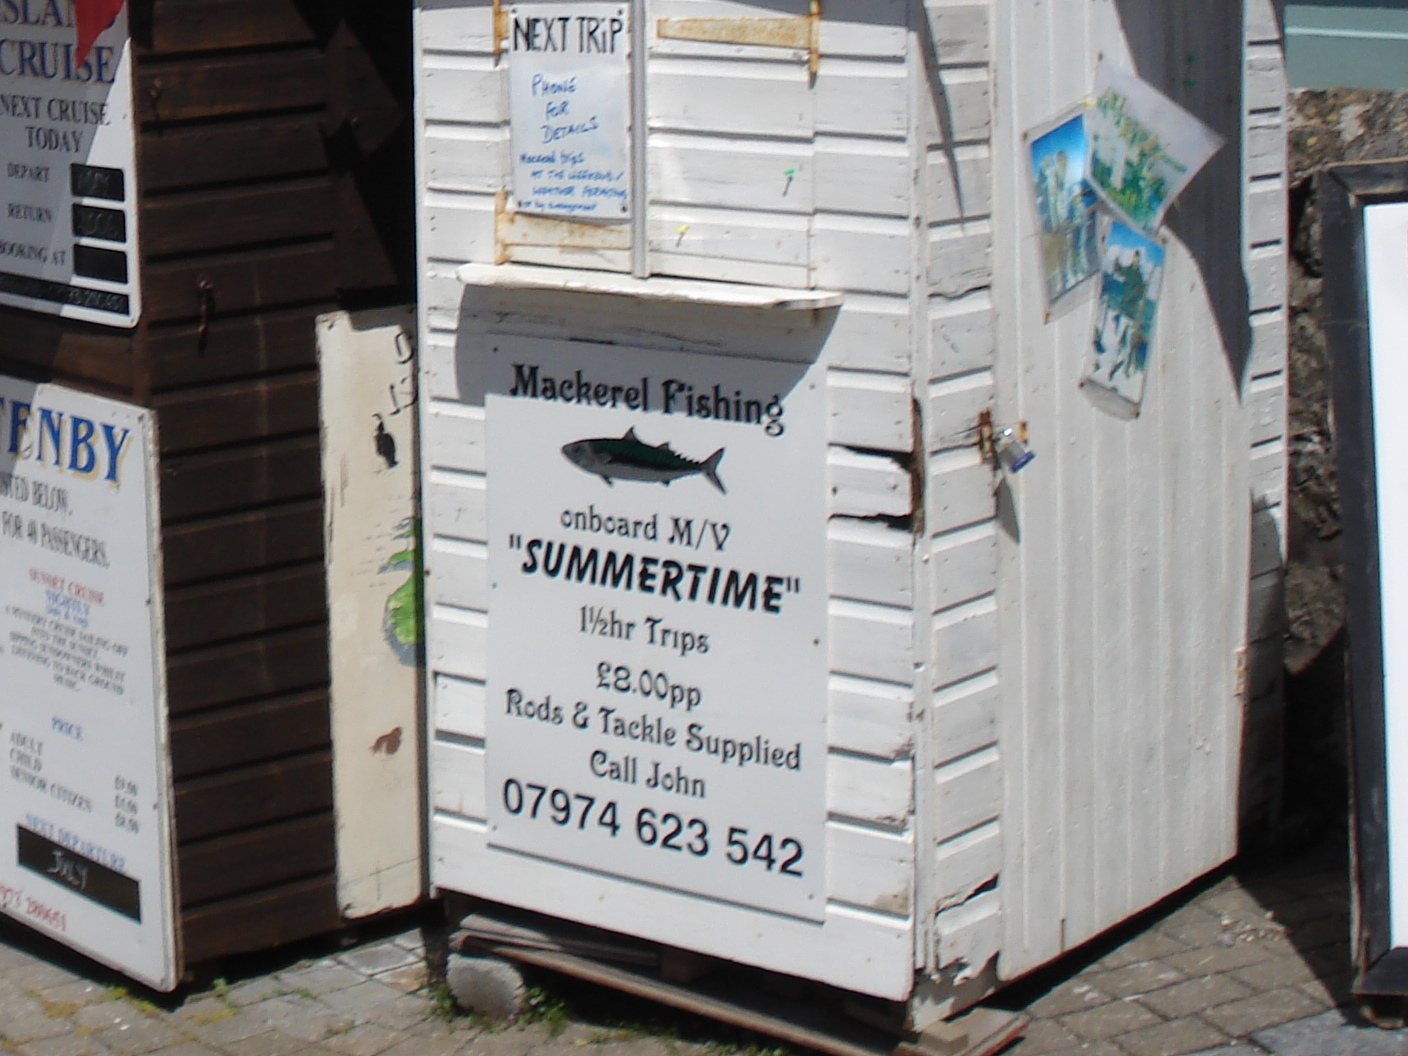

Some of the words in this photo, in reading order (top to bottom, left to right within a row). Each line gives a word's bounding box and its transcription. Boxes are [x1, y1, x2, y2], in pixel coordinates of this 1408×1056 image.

[512, 16, 571, 52] NEXT
[0, 94, 42, 119] NEXT
[48, 97, 110, 126] CRUISE
[25, 125, 83, 152] TODAY
[509, 363, 648, 412] Mackerel
[662, 378, 784, 437] Fishing
[560, 504, 658, 542] onboard
[668, 517, 731, 551] M/V
[509, 533, 800, 613] "SUMMERTIME"
[645, 617, 710, 656] Trips
[597, 661, 702, 711] £8.00pp
[505, 688, 563, 724] Rods
[572, 701, 589, 729] &
[598, 707, 677, 746] Tackle
[686, 723, 801, 772] Supplied
[590, 750, 637, 784] Call
[646, 762, 706, 798] John
[503, 778, 620, 838] 07974
[636, 807, 710, 857] 623
[727, 827, 803, 877] 542
